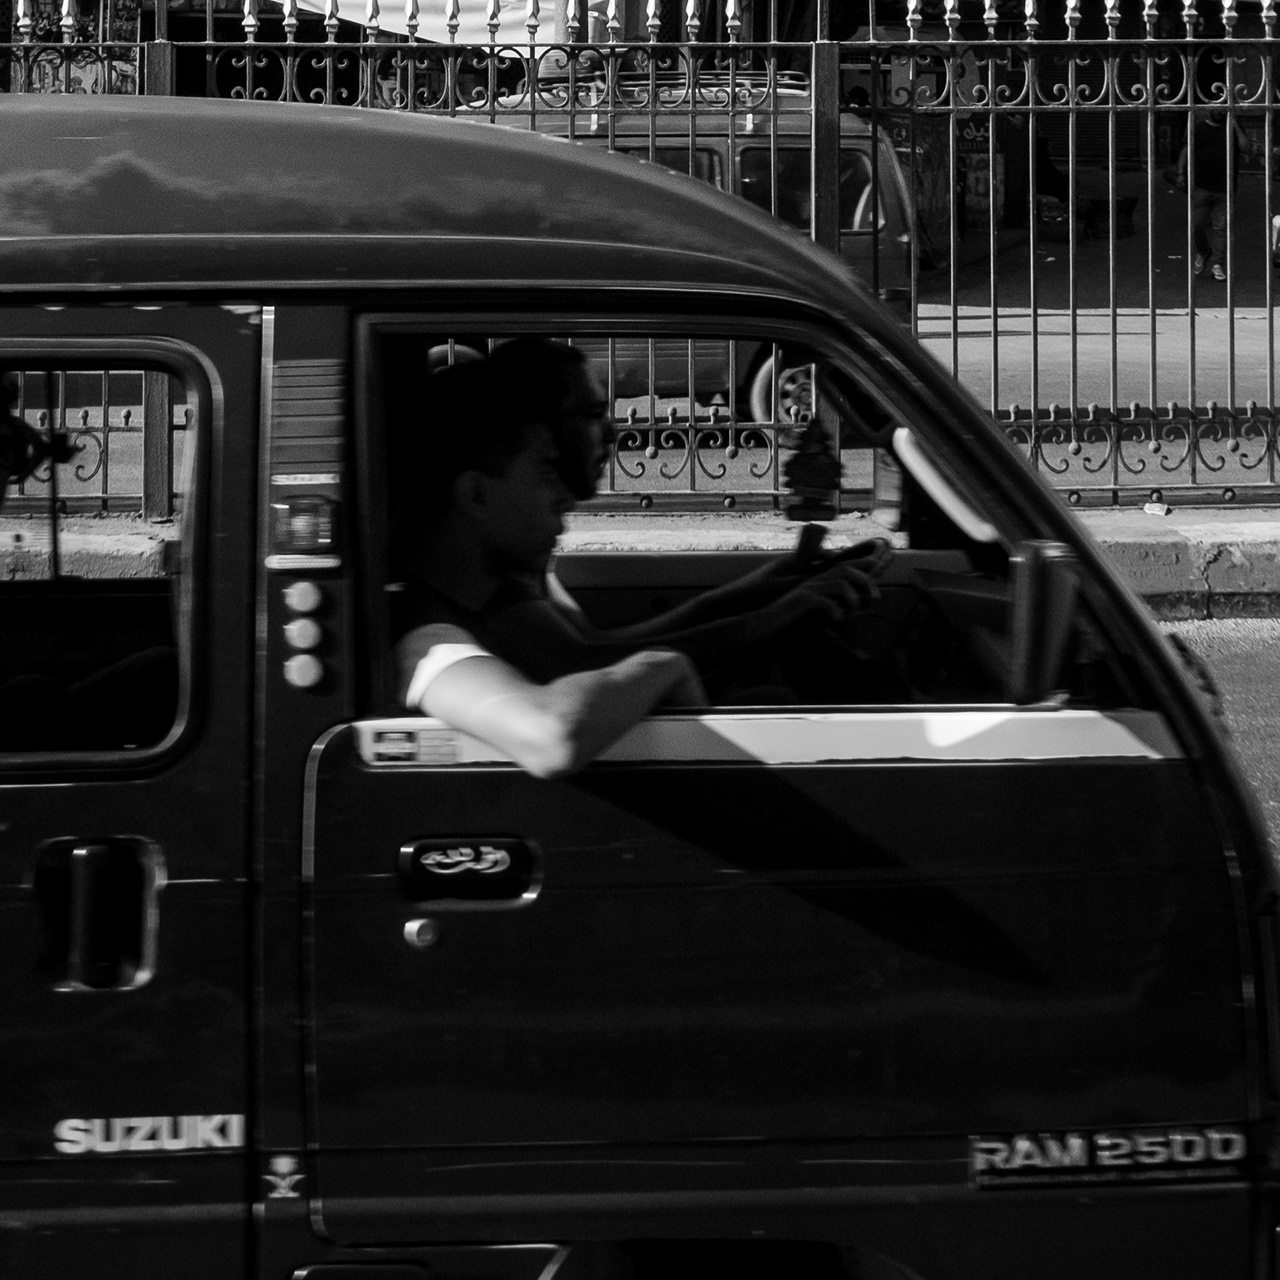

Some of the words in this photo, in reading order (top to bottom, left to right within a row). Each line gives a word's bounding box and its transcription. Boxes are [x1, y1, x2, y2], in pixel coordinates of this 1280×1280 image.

[52, 1113, 247, 1154] SUZUKI
[968, 1133, 1089, 1171] RAM
[1093, 1129, 1248, 1166] 2500
